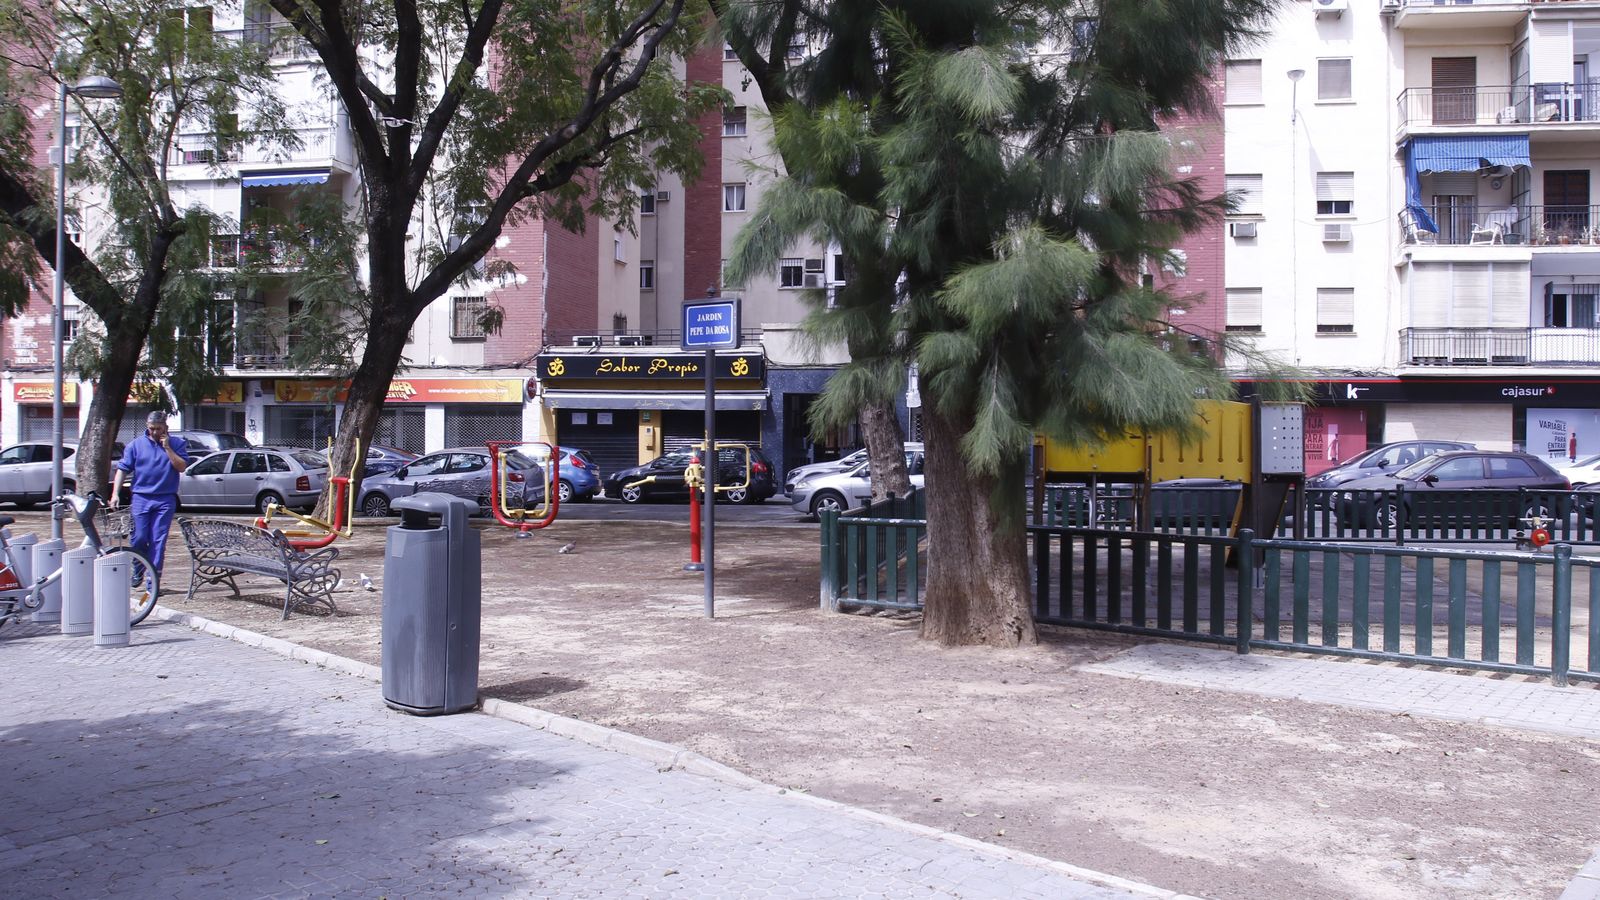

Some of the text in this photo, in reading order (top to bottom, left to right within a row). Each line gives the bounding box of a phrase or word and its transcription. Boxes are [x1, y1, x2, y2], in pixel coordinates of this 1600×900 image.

[697, 313, 723, 322] JARDIN
[690, 325, 730, 336] PEPE DA ROSA
[595, 357, 698, 378] Sabor Propio
[1502, 386, 1544, 398] cajasur
[1539, 420, 1567, 432] VARIABLE
